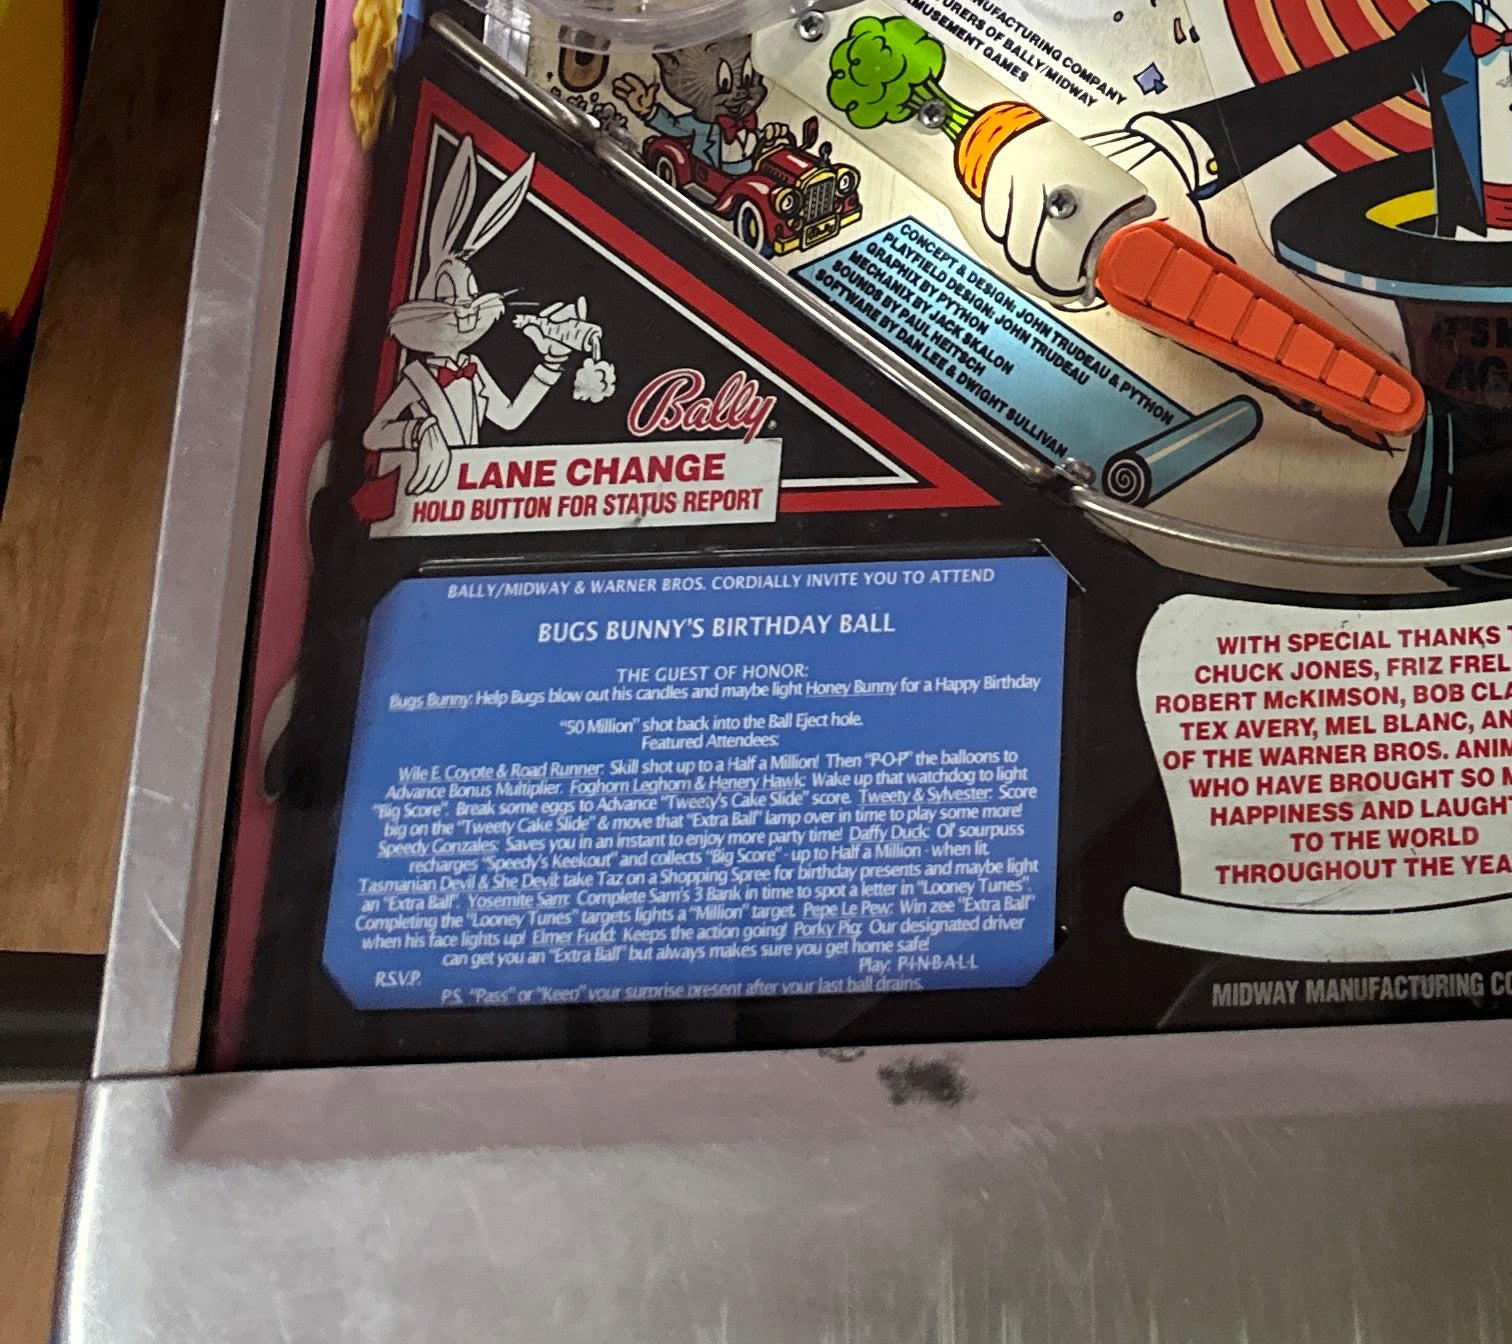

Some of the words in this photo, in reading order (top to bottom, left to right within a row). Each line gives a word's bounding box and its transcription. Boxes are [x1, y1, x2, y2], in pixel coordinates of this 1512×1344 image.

[983, 45, 1029, 82] GAMES
[985, 25, 1005, 43] OF
[1003, 38, 1098, 107] BALLY/MIDWAY
[1062, 56, 1127, 105] COMPANY
[867, 242, 919, 287] GRAPHIX
[919, 281, 938, 301] BY
[936, 292, 989, 335] PYTHON
[883, 232, 947, 283] PLAYFIELD
[949, 275, 996, 321] DESIGN:
[995, 314, 1030, 347] JOHN
[1030, 337, 1090, 385] TRUDEAU
[900, 224, 958, 268] CONCEPT
[957, 264, 968, 277] &
[968, 272, 1016, 310] DESIGN:
[1016, 306, 1052, 336] JOHN
[1050, 328, 1111, 379] TRUDEAU
[1109, 374, 1119, 388] &
[1119, 381, 1174, 425] PYTHON
[628, 369, 777, 444] Bally
[457, 460, 558, 490] LANE
[566, 453, 726, 487] CHANGE
[412, 499, 464, 523] HOLD
[471, 495, 553, 520] BUTTON
[558, 495, 597, 516] FOR
[603, 492, 677, 515] STATUS
[684, 488, 763, 512] REPORT
[448, 582, 572, 599] BALLY/MIDWAY
[574, 581, 585, 594] &
[591, 578, 657, 593] WARNER
[662, 577, 706, 591] BROS.
[712, 575, 802, 590] CORDIALLY
[806, 573, 859, 587] INVITE
[864, 572, 897, 585] YOU
[902, 571, 924, 584] TO
[930, 569, 995, 583] ATTEND
[537, 621, 598, 643] BUGS
[606, 618, 704, 640] BUNNY'S
[712, 616, 831, 637] BIRTHDAY
[840, 613, 896, 634] BALL
[1217, 636, 1280, 655] WITH
[1288, 631, 1389, 652] SPECIAL
[1398, 626, 1500, 647] THANKS
[1194, 661, 1283, 684] CHUCK
[1290, 659, 1380, 680] JONES,
[1387, 655, 1443, 675] FRIZ
[1156, 691, 1256, 713] ROBERT
[1264, 685, 1406, 710] McKIMSON,
[1413, 682, 1465, 704] BOB
[1181, 721, 1229, 741] TEX
[1235, 717, 1319, 740] AVERY,
[1325, 715, 1377, 735] MEL
[1383, 712, 1476, 735] BLANC,
[1163, 751, 1199, 770] OF
[1204, 748, 1253, 767] THE
[1259, 744, 1367, 767] WARNER
[1373, 741, 1449, 761] BROS.
[1189, 777, 1249, 798] WHO
[1256, 774, 1322, 796] HAVE
[1330, 769, 1454, 792] BROUGHT
[1461, 767, 1495, 786] SO
[1210, 803, 1354, 826] HAPPINESS
[1360, 800, 1414, 820] AND
[1290, 832, 1322, 852] TO
[1330, 830, 1381, 850] THE
[1387, 826, 1480, 849] WORLD
[1215, 859, 1396, 884] THROUGHOUT
[1405, 856, 1458, 877] THE
[1213, 979, 1297, 1008] MIDWAY
[1305, 972, 1484, 1003] MANUFACTURING
